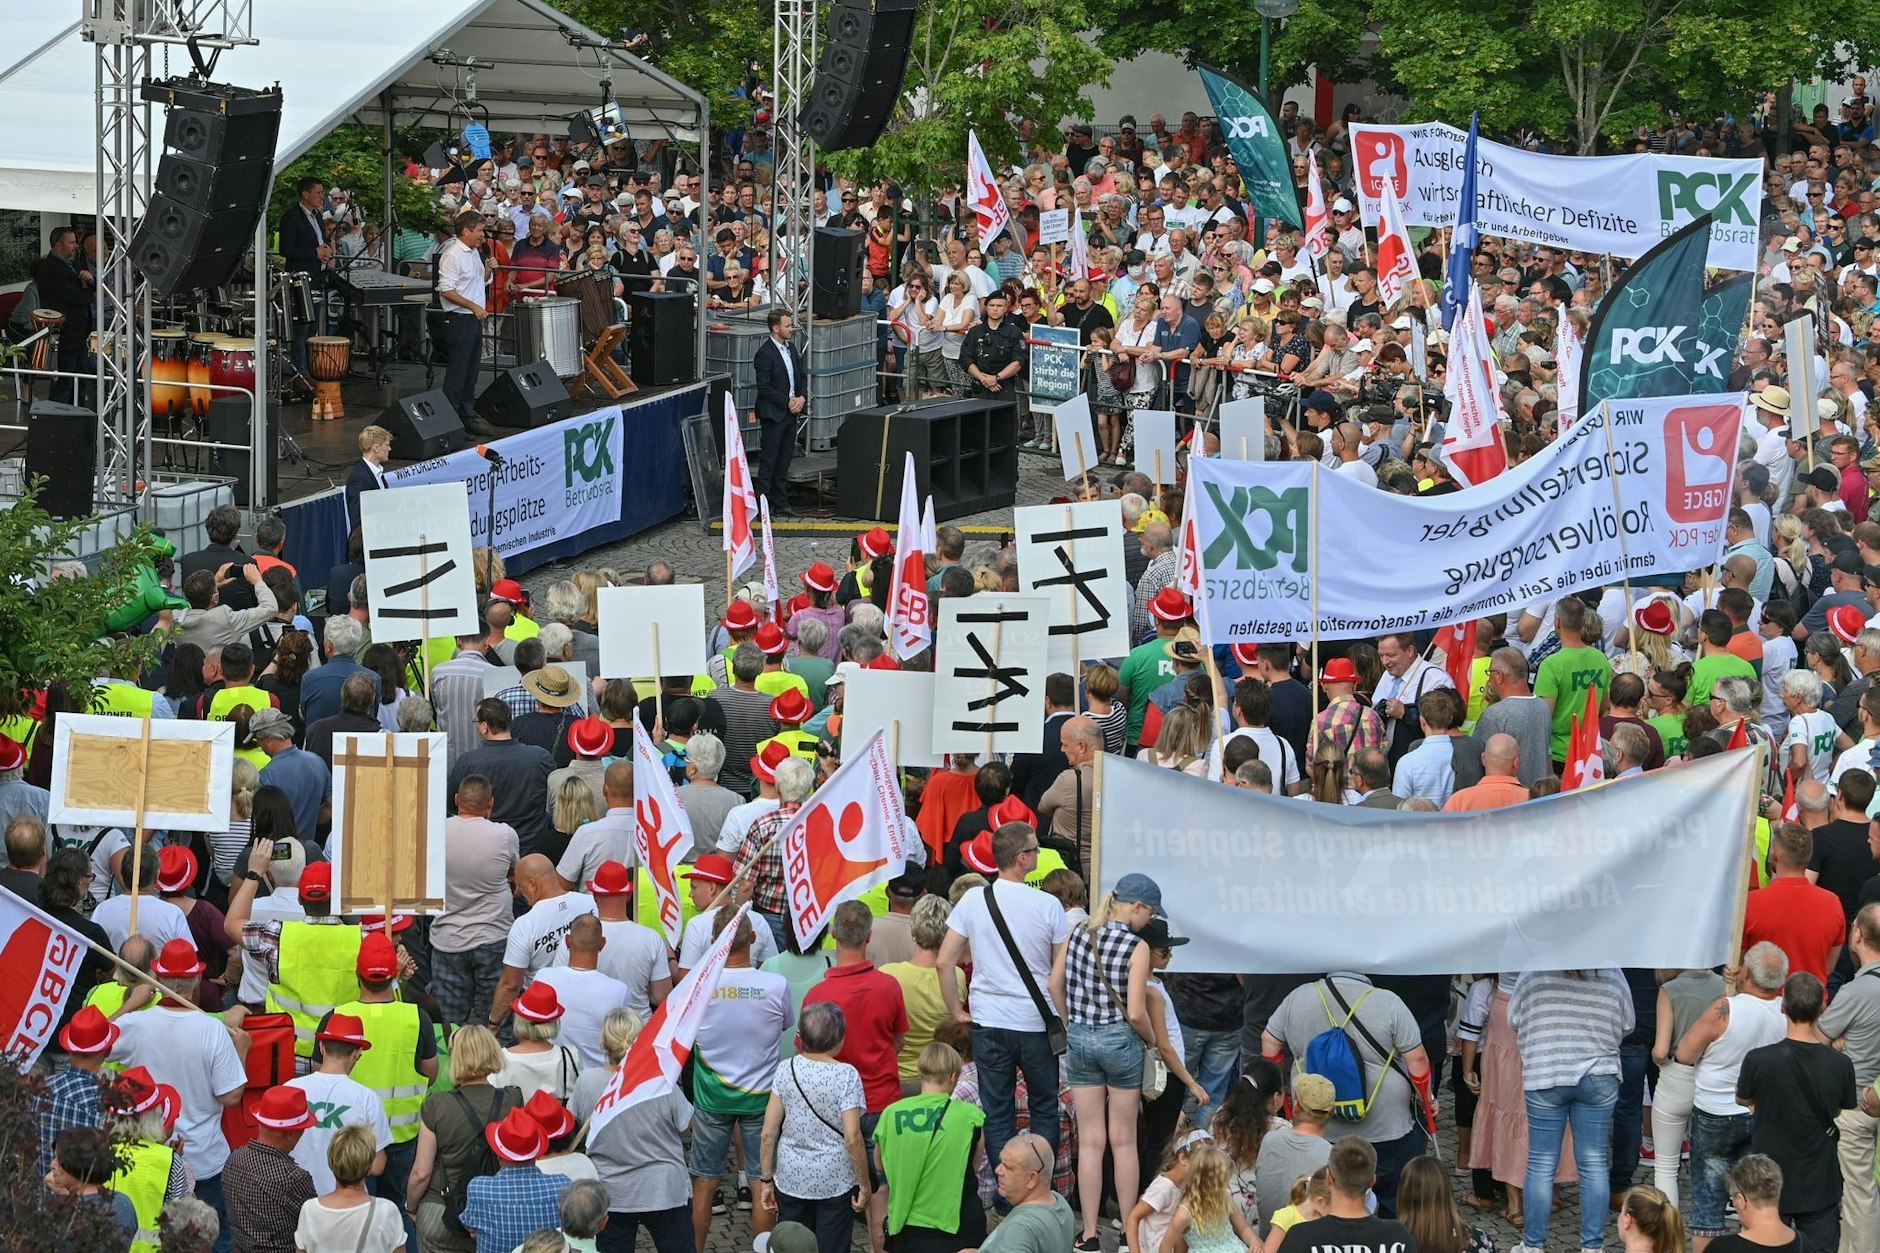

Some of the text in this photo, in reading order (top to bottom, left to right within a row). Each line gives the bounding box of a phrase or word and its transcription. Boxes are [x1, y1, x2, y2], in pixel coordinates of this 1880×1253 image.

[1430, 127, 1466, 143] FORDER
[1414, 148, 1493, 178] Ausgleh
[1371, 179, 1400, 191] IGE
[1657, 169, 1760, 227] PCK
[1418, 182, 1638, 235] wirtscaftlicher Defizite
[1491, 221, 1509, 234] und
[1512, 225, 1569, 245] Arbeitgeber
[1661, 221, 1755, 244] Beebsrat
[1610, 325, 1688, 365] PCK
[1034, 366, 1075, 379] stirbt die
[1044, 354, 1066, 366] PCK,
[1037, 377, 1072, 391] Region!
[563, 416, 616, 488] PCK
[471, 497, 546, 537] dungsplätze
[493, 525, 556, 554] hemischen Industrie
[1572, 668, 1604, 692] PCK
[887, 823, 903, 860] Energie
[535, 921, 572, 951] FOR TH
[712, 986, 738, 1000] 018
[308, 1101, 352, 1129] CK
